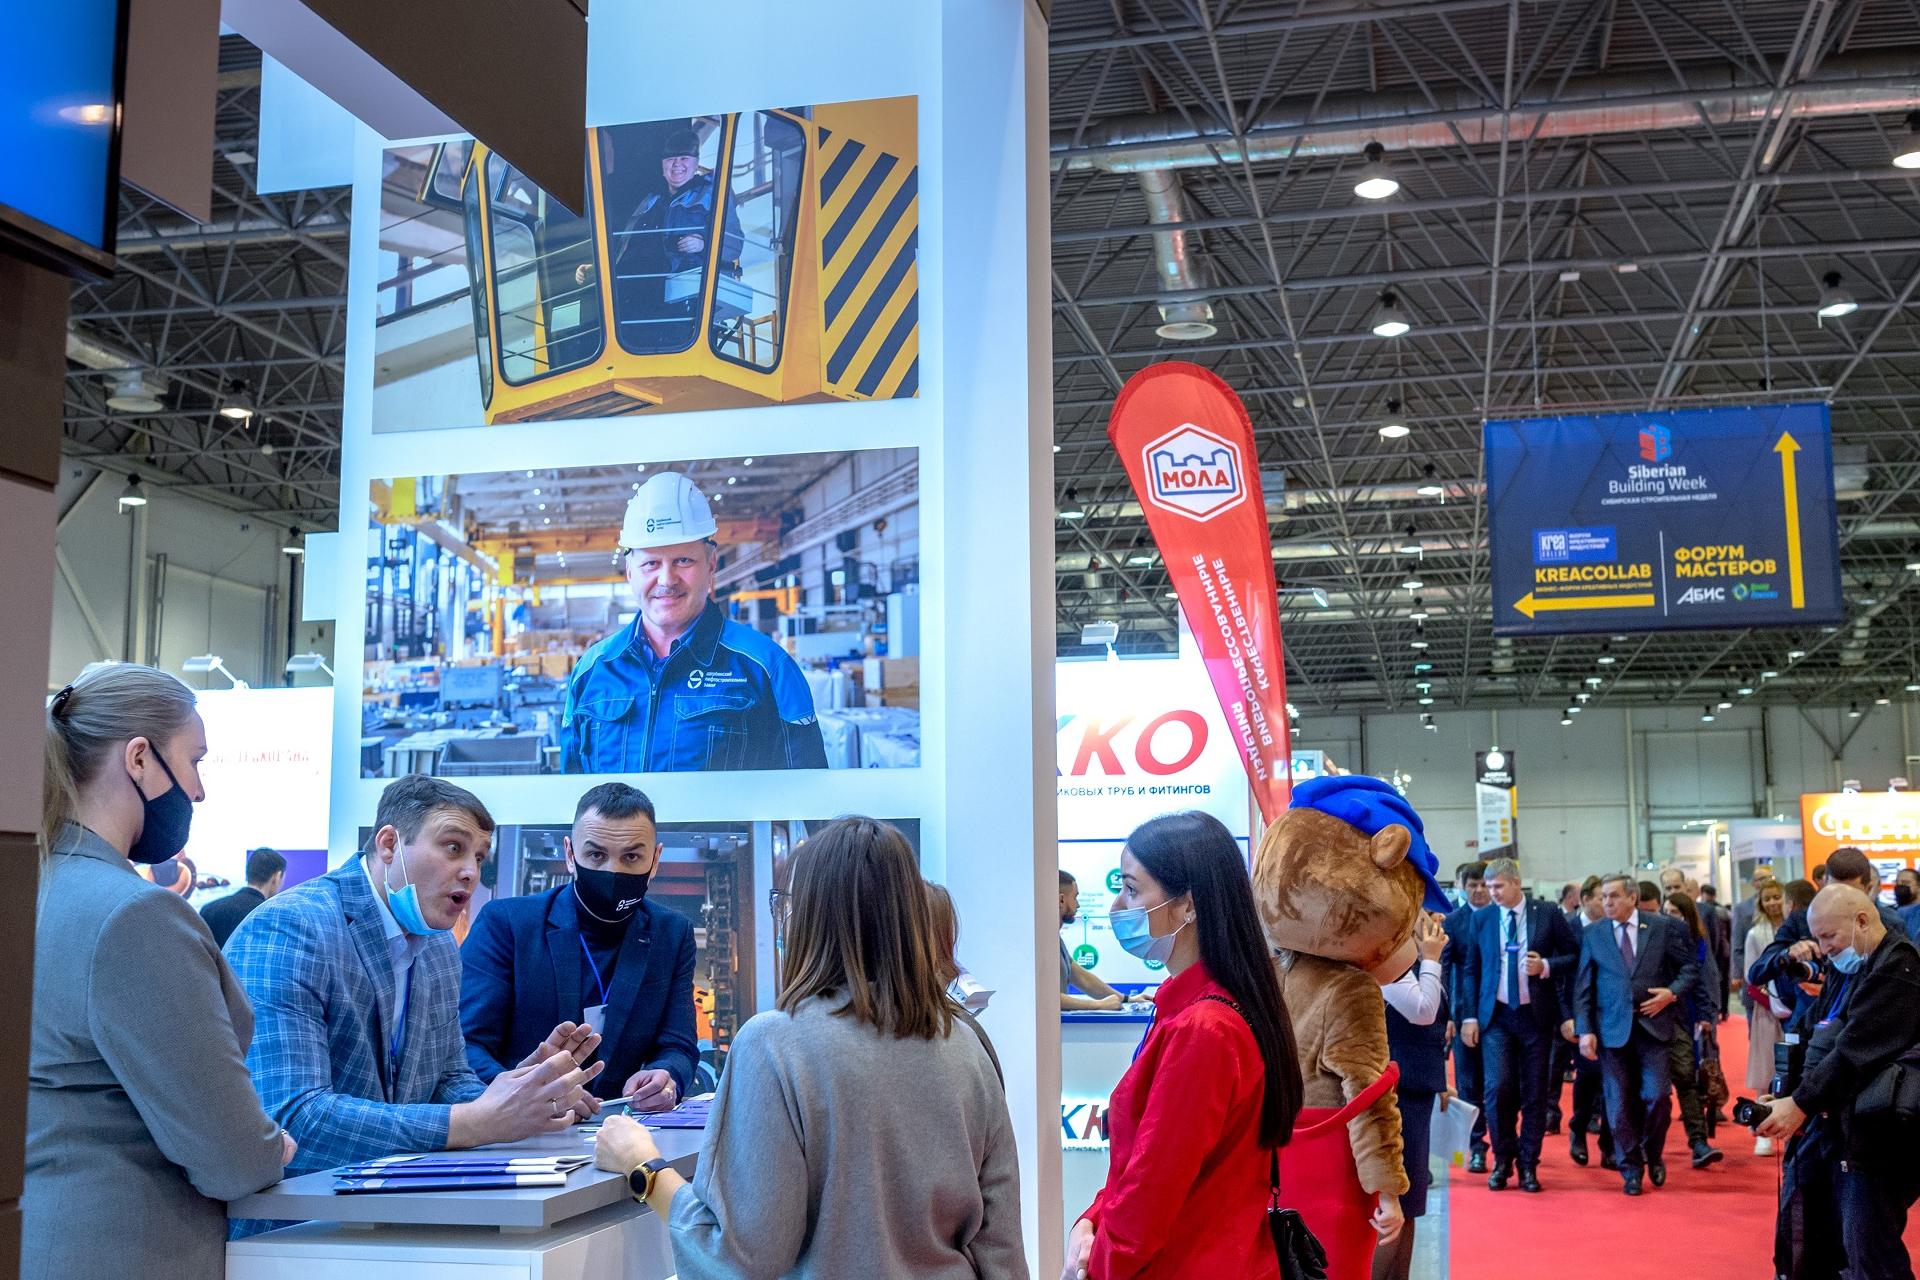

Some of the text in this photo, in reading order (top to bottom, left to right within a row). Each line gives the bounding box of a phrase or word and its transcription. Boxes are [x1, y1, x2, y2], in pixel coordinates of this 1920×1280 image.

[1628, 463, 1686, 479] Siberian
[1608, 475, 1707, 495] Building Week
[1674, 544, 1744, 562] ФОРУМ
[1535, 563, 1652, 583] KREACOLLAB
[1675, 558, 1777, 578] МАСТЕРОВ
[1676, 586, 1725, 604] АБИС
[1108, 786, 1135, 796] ТРУБ
[1139, 786, 1146, 795] И
[1149, 784, 1211, 795] ФИТИНГОВ
